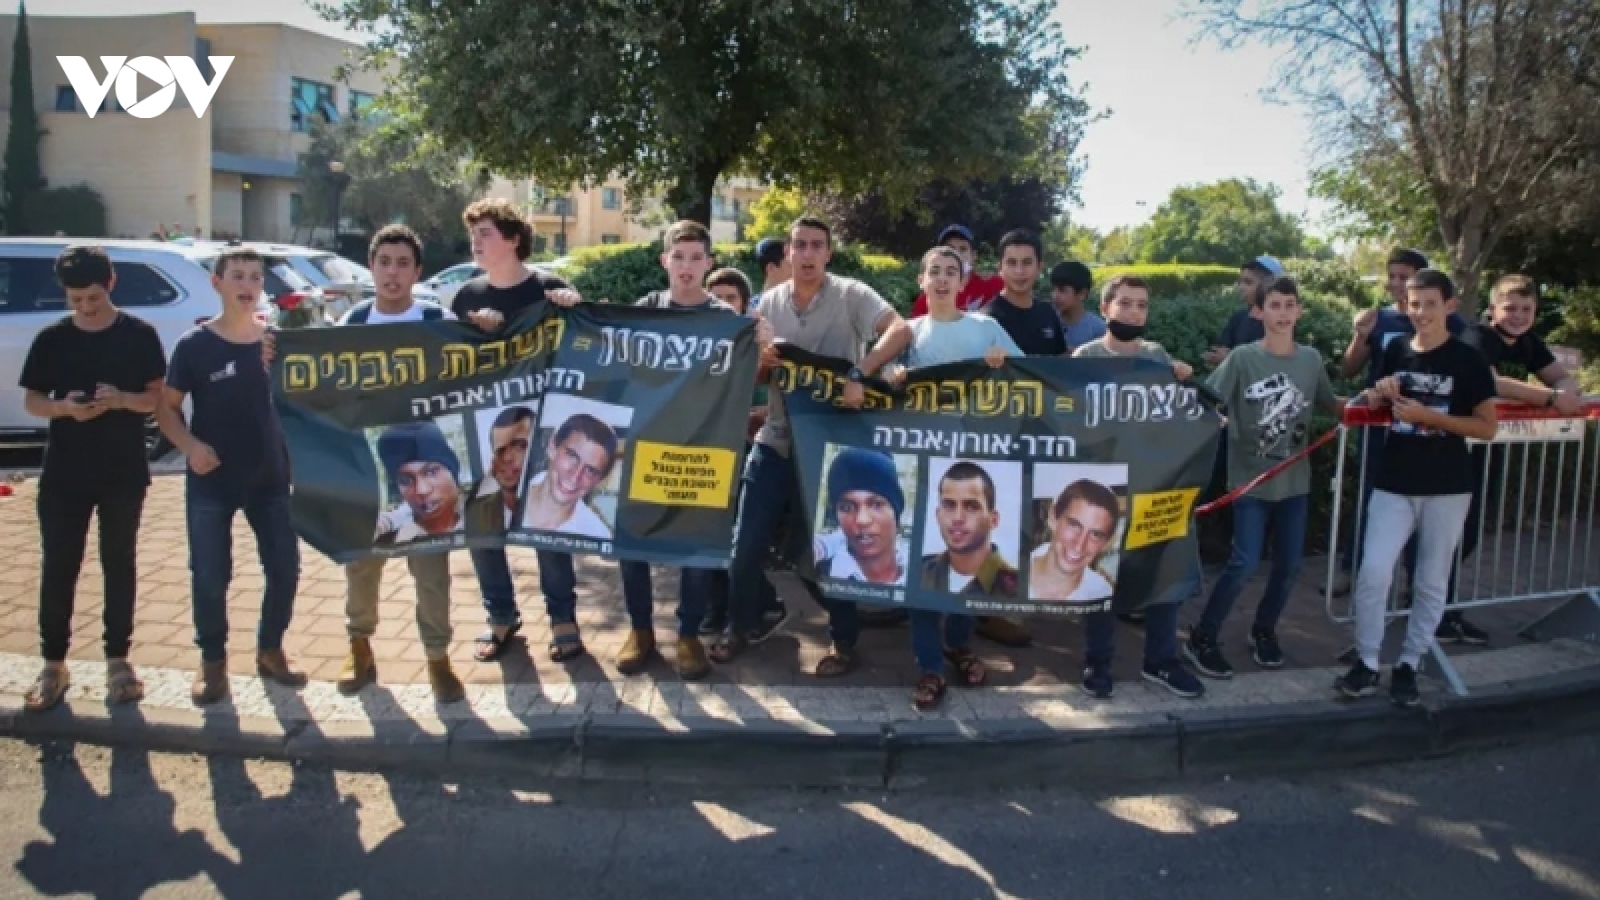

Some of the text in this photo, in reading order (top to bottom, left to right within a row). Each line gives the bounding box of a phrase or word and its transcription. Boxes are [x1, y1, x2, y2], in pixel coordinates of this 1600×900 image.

[283, 346, 427, 393] הבנים
[438, 317, 566, 379] השבת
[597, 325, 735, 376] ניצחון
[904, 378, 1044, 419] השבת
[1085, 381, 1205, 428] ניצחון
